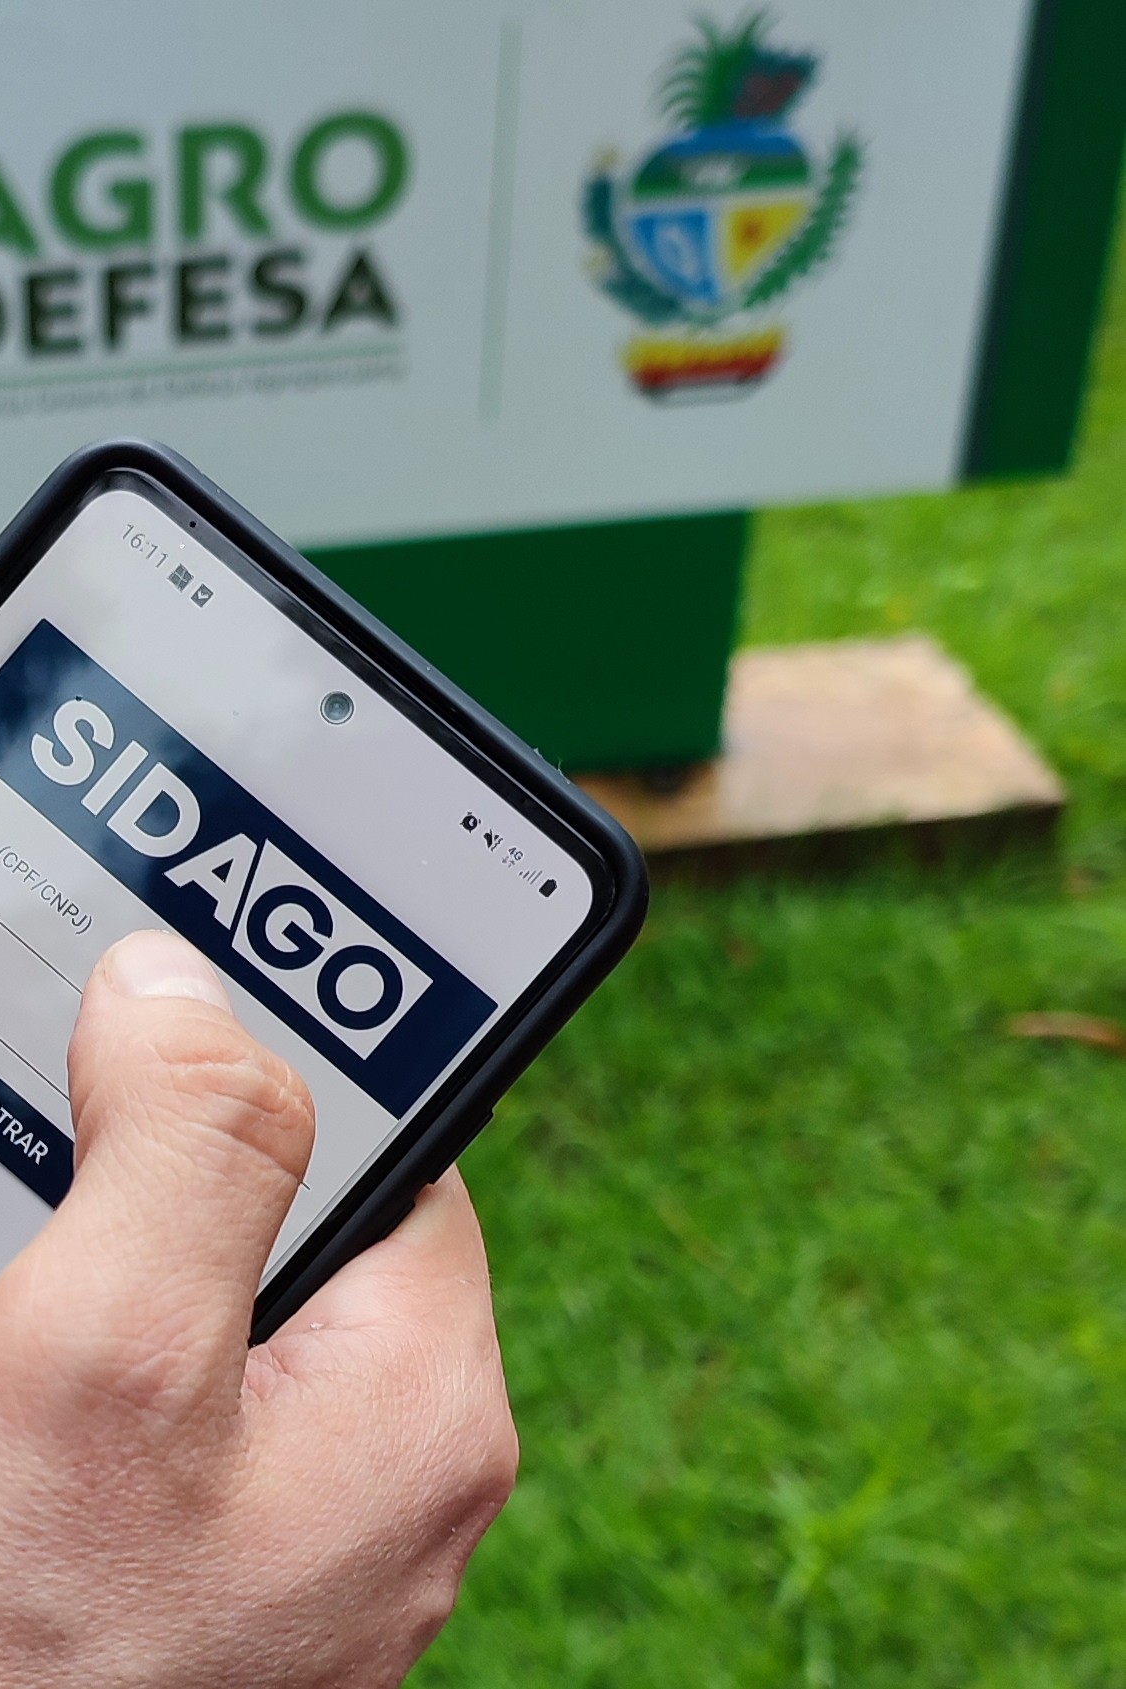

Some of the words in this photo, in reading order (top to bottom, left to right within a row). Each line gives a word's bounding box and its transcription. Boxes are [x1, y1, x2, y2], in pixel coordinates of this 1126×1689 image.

[122, 523, 169, 569] 16:11
[30, 698, 404, 1031] SIDAGO
[508, 846, 524, 861] 4G
